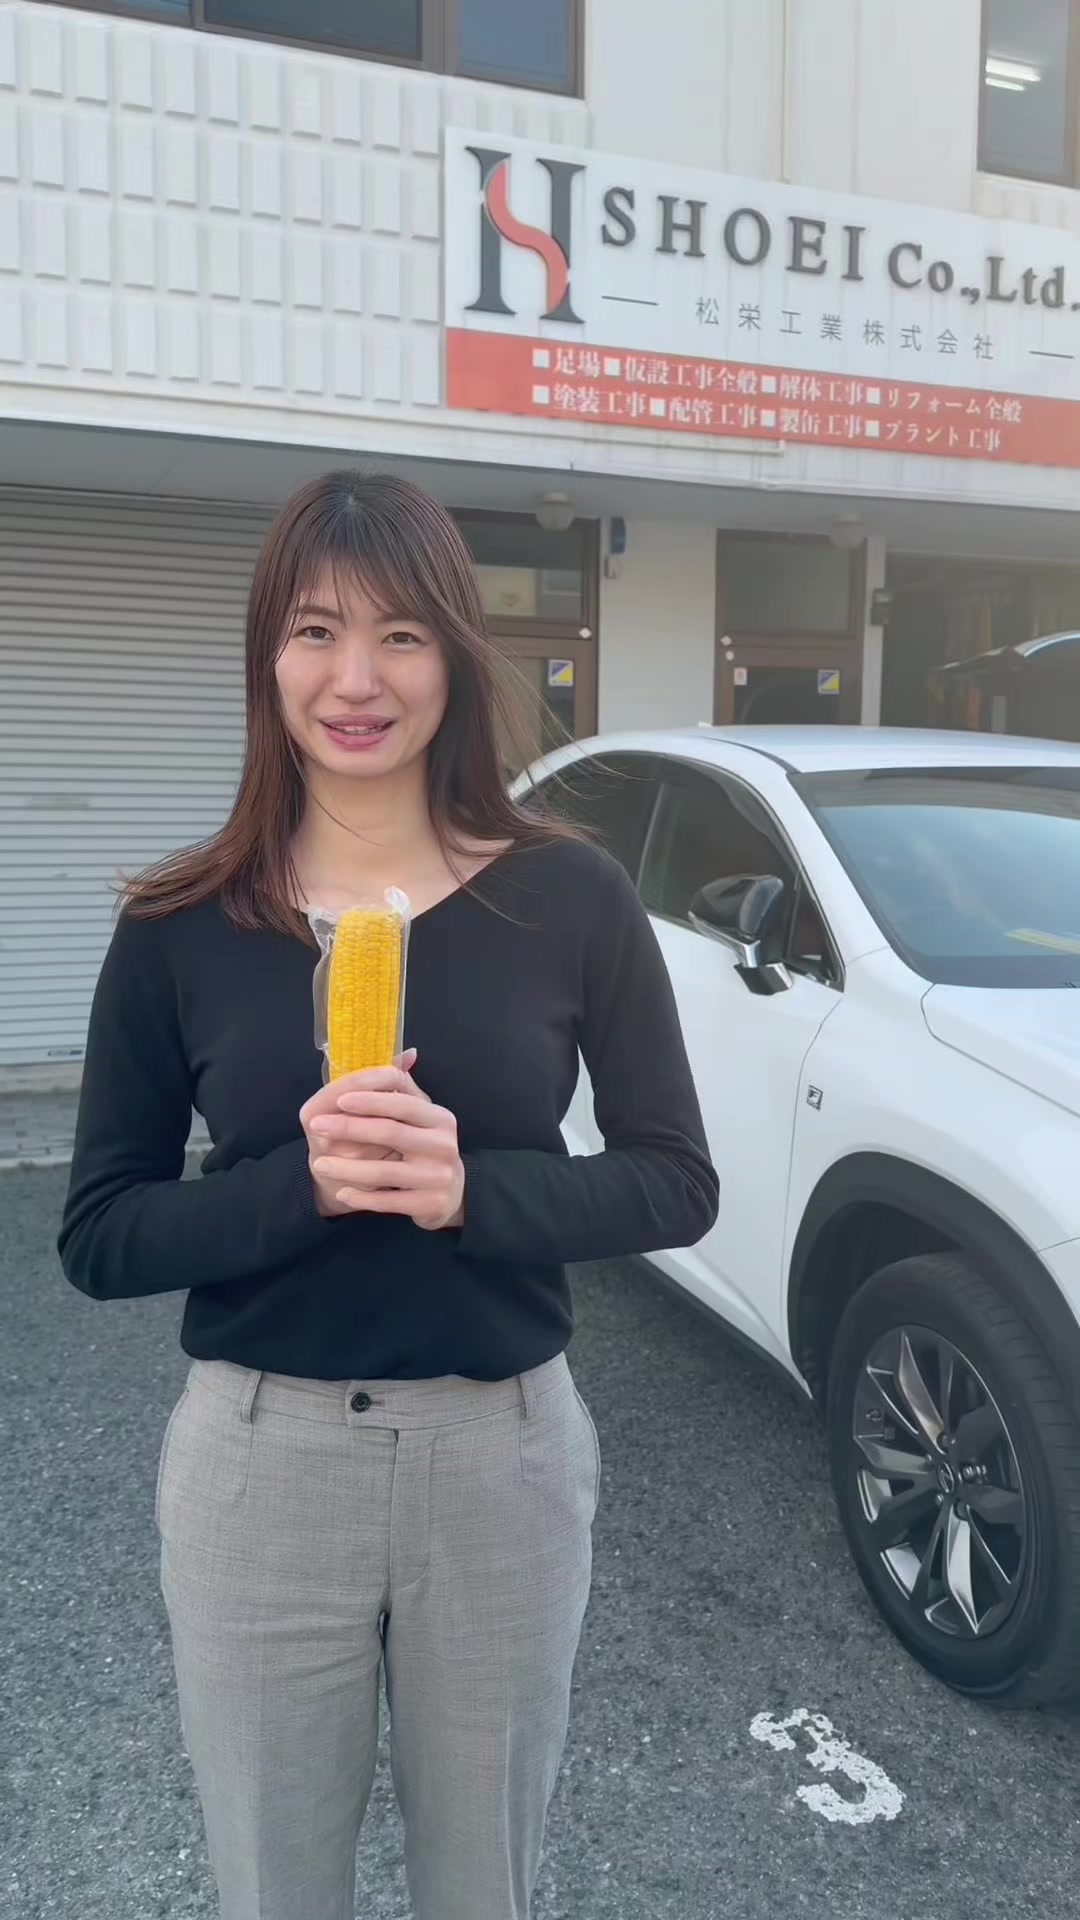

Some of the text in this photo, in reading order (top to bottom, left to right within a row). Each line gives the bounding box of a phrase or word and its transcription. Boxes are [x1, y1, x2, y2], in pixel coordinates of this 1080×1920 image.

[601, 186, 866, 282] SHOEI
[695, 296, 995, 360] 松栄工業株式会社
[554, 348, 1023, 424] 足場 仮設工事全般 解体工事 リフォーム全般
[554, 384, 646, 417] 塗装工事
[669, 397, 758, 429] 配管工事
[885, 420, 1002, 451] プラント工事
[749, 1708, 906, 1826] 3
